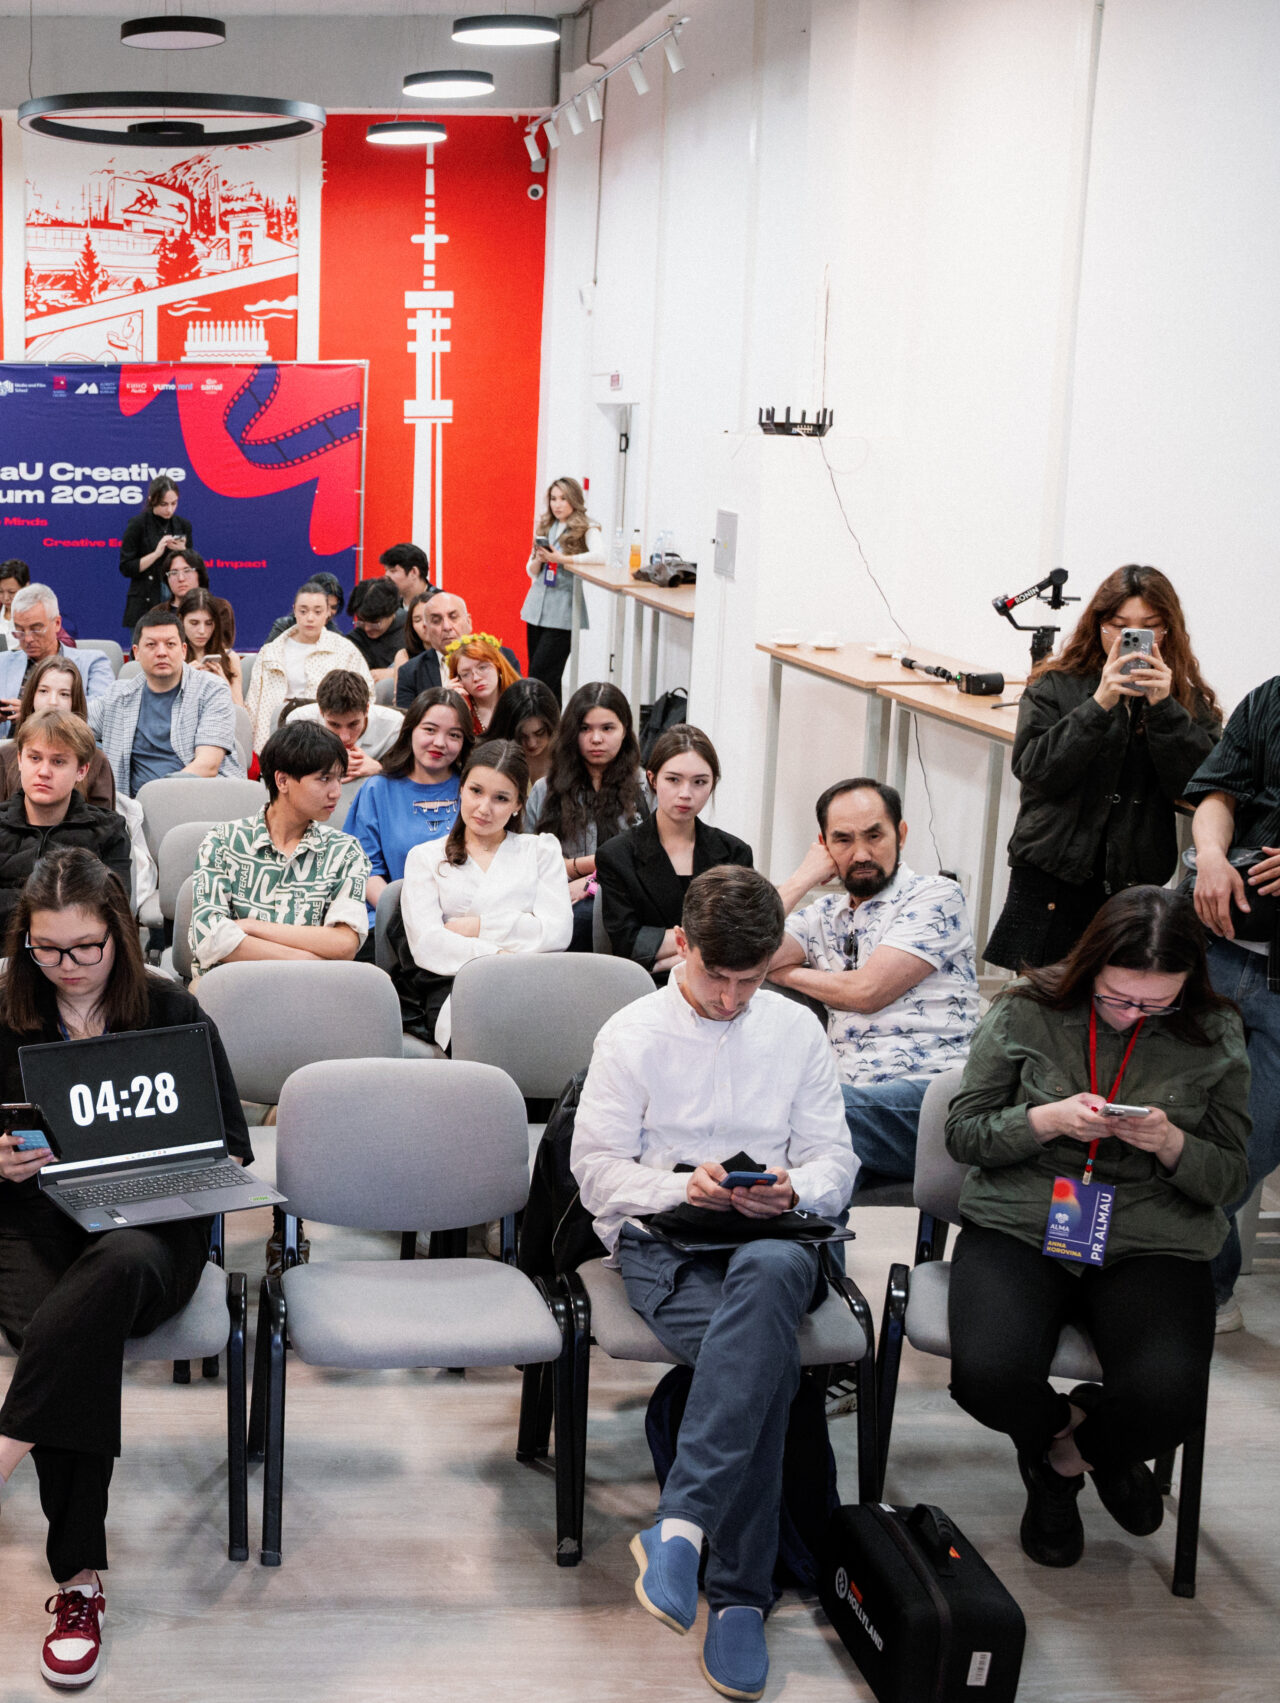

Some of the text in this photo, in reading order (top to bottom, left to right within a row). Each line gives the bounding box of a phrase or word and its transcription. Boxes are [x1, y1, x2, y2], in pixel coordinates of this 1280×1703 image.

[49, 463, 186, 482] Creative
[51, 485, 144, 504] 2026
[4, 516, 48, 527] Minds
[43, 538, 106, 548] Creative
[216, 558, 268, 570] Impact
[1014, 586, 1039, 604] RONIN
[237, 863, 250, 898] BTERAE
[69, 1072, 179, 1127] 04:28
[1050, 1223, 1070, 1233] ALMA
[1090, 1193, 1112, 1261] PR ALMAU
[1046, 1246, 1082, 1257] KOROVINA
[1047, 1240, 1067, 1249] ANNA
[847, 1588, 884, 1652] HOLLYLAND
